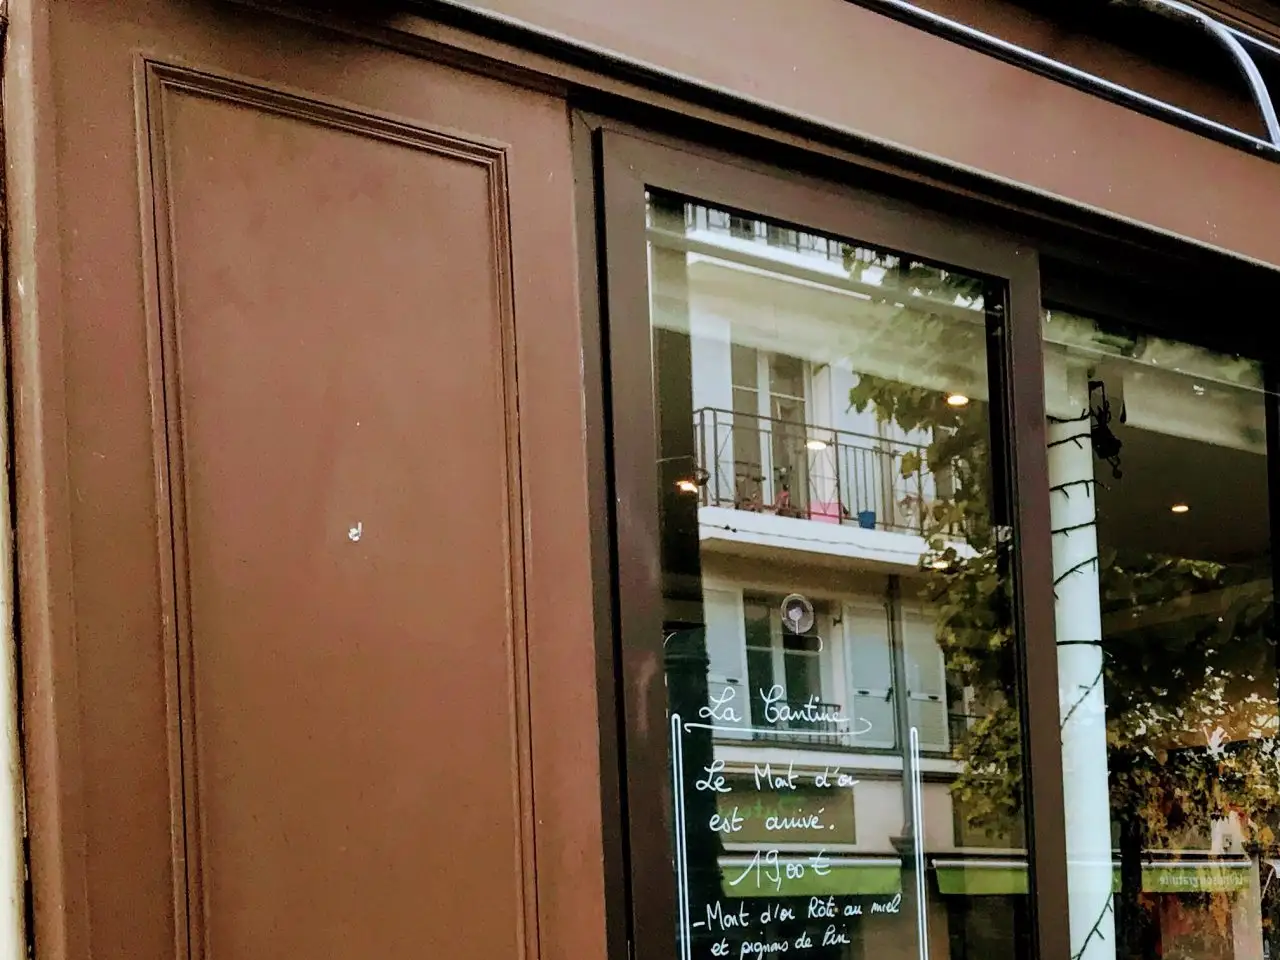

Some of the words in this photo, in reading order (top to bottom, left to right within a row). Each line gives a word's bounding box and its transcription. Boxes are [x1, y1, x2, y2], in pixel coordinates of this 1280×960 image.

[698, 686, 743, 723] La
[760, 684, 850, 723] Cantine
[695, 759, 732, 793] Le
[754, 759, 799, 791] Mont
[709, 806, 744, 833] est
[844, 902, 863, 916] au
[871, 893, 902, 914] miel
[711, 937, 729, 957] et
[795, 930, 813, 948] de
[822, 924, 850, 947] Pin
